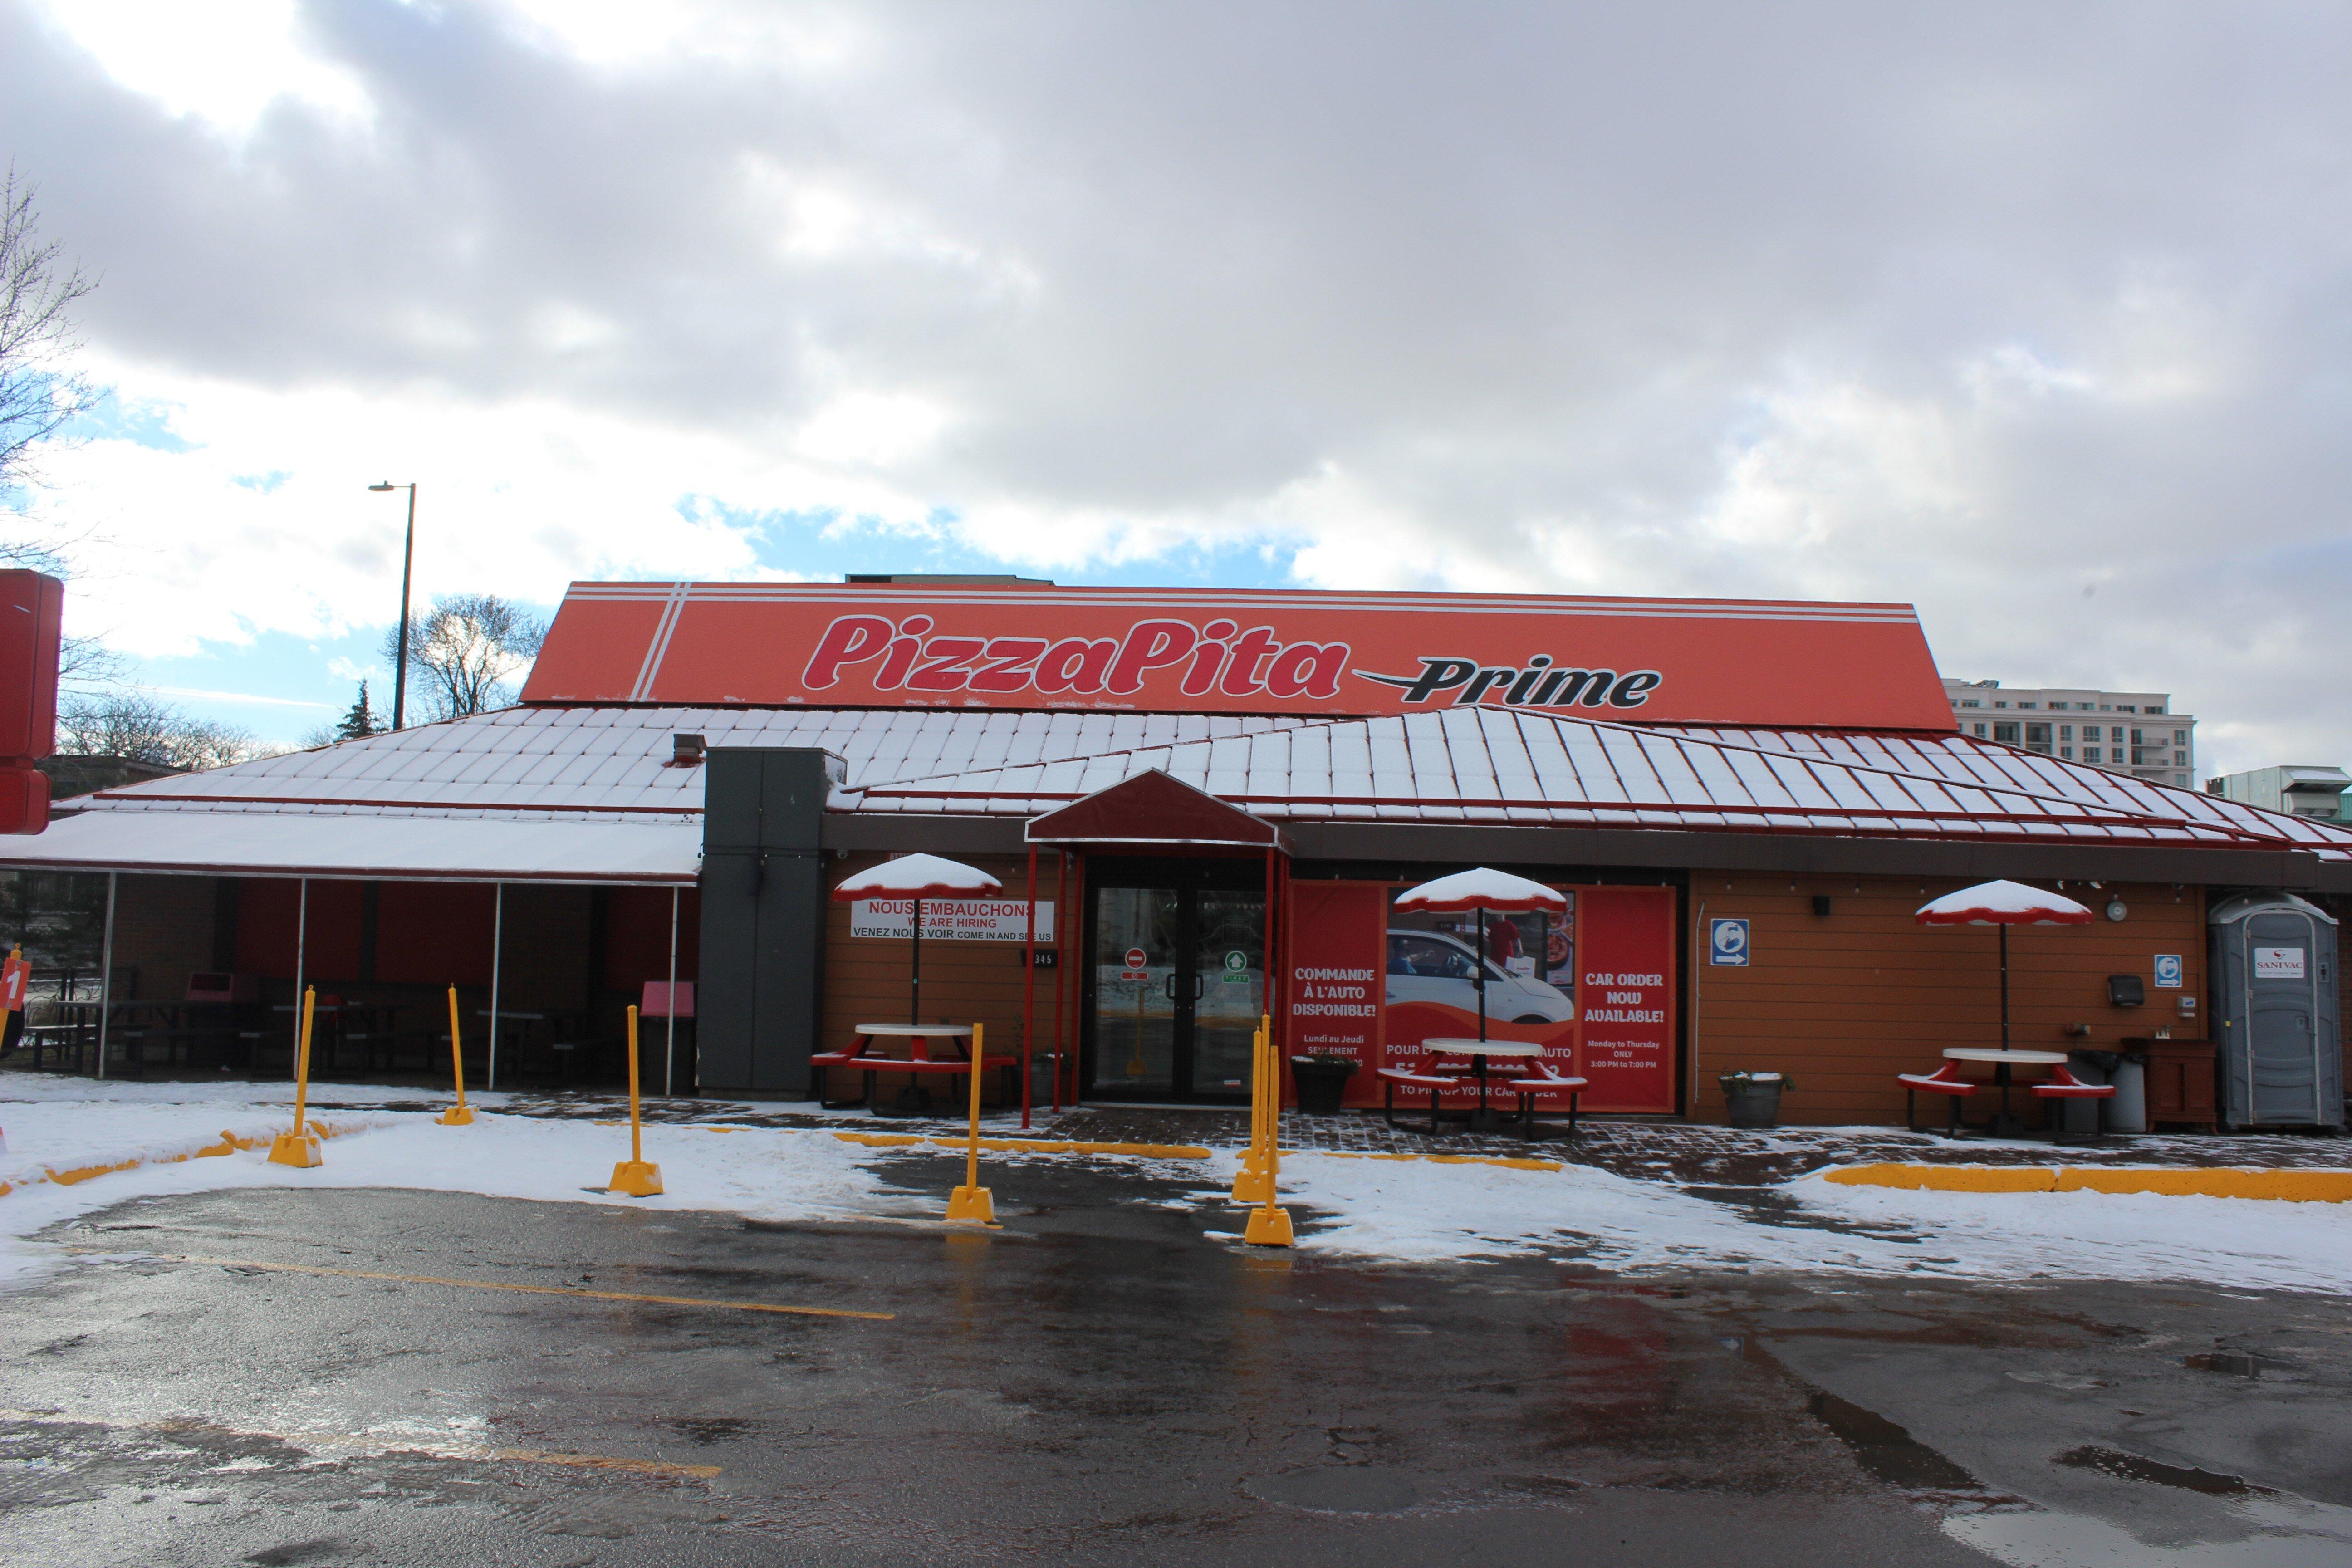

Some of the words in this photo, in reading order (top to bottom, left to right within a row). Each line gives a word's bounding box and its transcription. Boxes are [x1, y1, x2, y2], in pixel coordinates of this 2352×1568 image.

[802, 614, 1351, 699] PizzaPita
[1352, 653, 1662, 709] Prime
[869, 901, 915, 915] NOUS
[920, 902, 1036, 917] EMBAUCHON
[929, 918, 953, 927] ARE
[957, 918, 997, 928] HIRING
[854, 927, 890, 936] VENEZ
[928, 929, 954, 938] VOIR
[1295, 968, 1375, 981] COMMANDE
[1585, 973, 1614, 985] CAR
[1617, 974, 1663, 986] ORDER
[7, 970, 21, 999] 1
[1304, 982, 1314, 998] À
[1607, 992, 1642, 1004] NOW
[1293, 1003, 1376, 1017] DISPONIBLE!
[1584, 1009, 1664, 1023] AVAILABLE!
[1387, 1045, 1419, 1055] POUR
[1588, 1040, 1616, 1049] Monday
[1626, 1040, 1660, 1049] Thursday
[1401, 1085, 1415, 1095] TO
